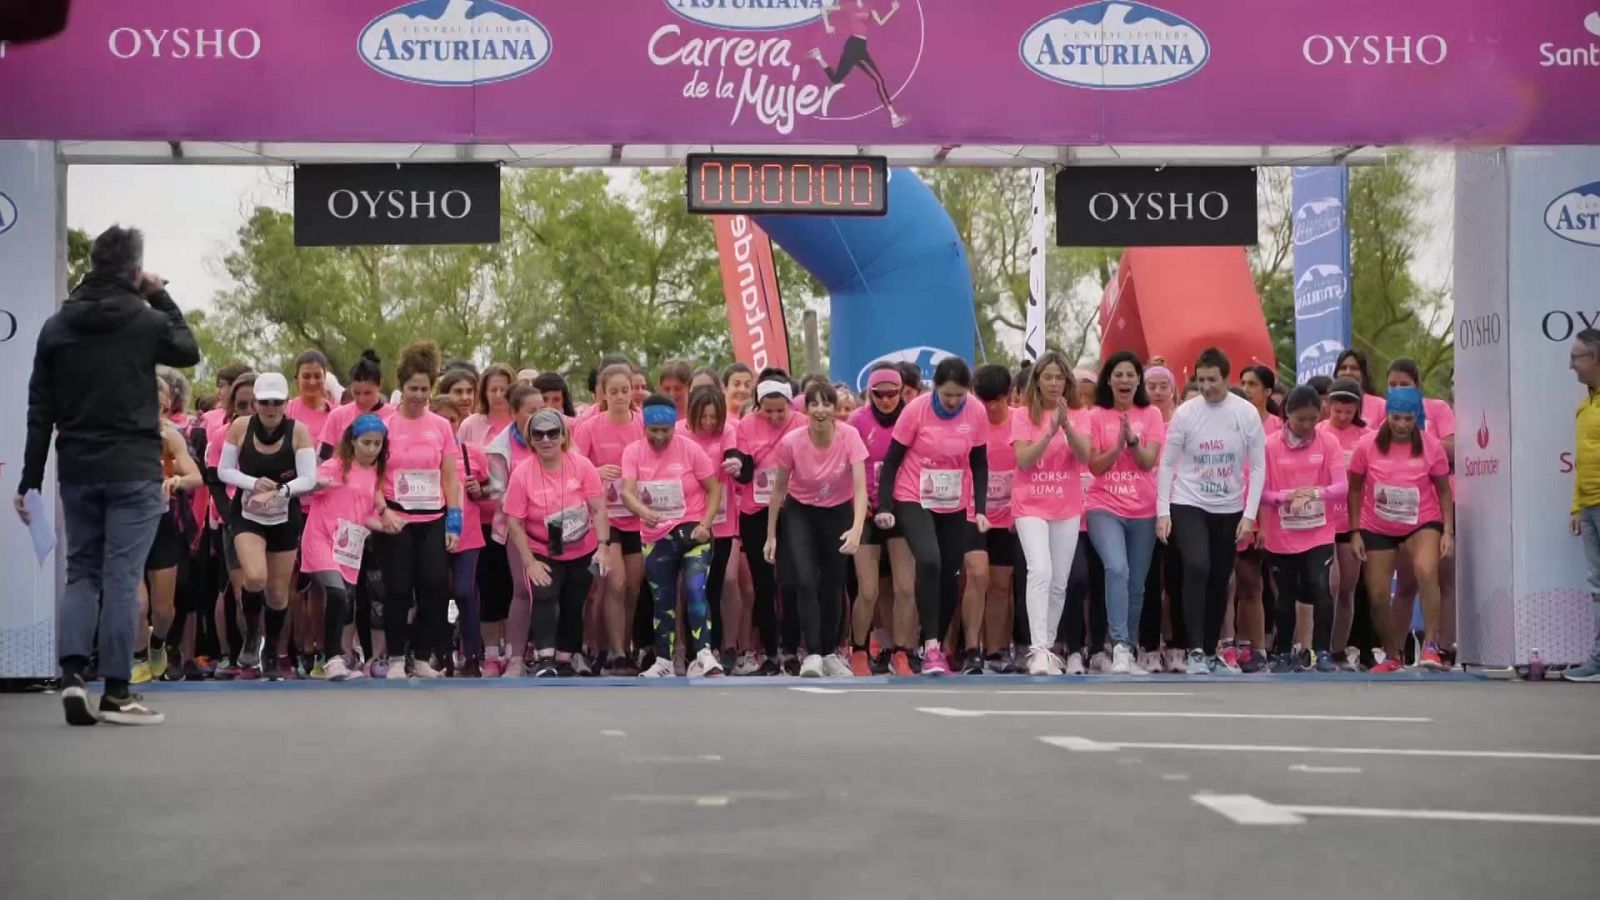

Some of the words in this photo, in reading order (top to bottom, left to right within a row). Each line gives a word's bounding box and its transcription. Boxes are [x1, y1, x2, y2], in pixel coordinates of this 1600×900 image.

[108, 27, 262, 60] OYSHO
[374, 28, 537, 62] ASTURIANA
[648, 24, 792, 66] Carrera
[1035, 33, 1195, 66] ASTURIANA
[1302, 34, 1448, 65] OYSHO
[682, 69, 710, 99] de
[715, 70, 735, 98] la
[730, 64, 845, 135] Mujer
[327, 189, 472, 219] OYSHO
[1088, 191, 1229, 222] OYSHO
[1459, 312, 1501, 349] OYSHO
[1030, 485, 1064, 496] SUMA
[1031, 471, 1070, 482] DORSA
